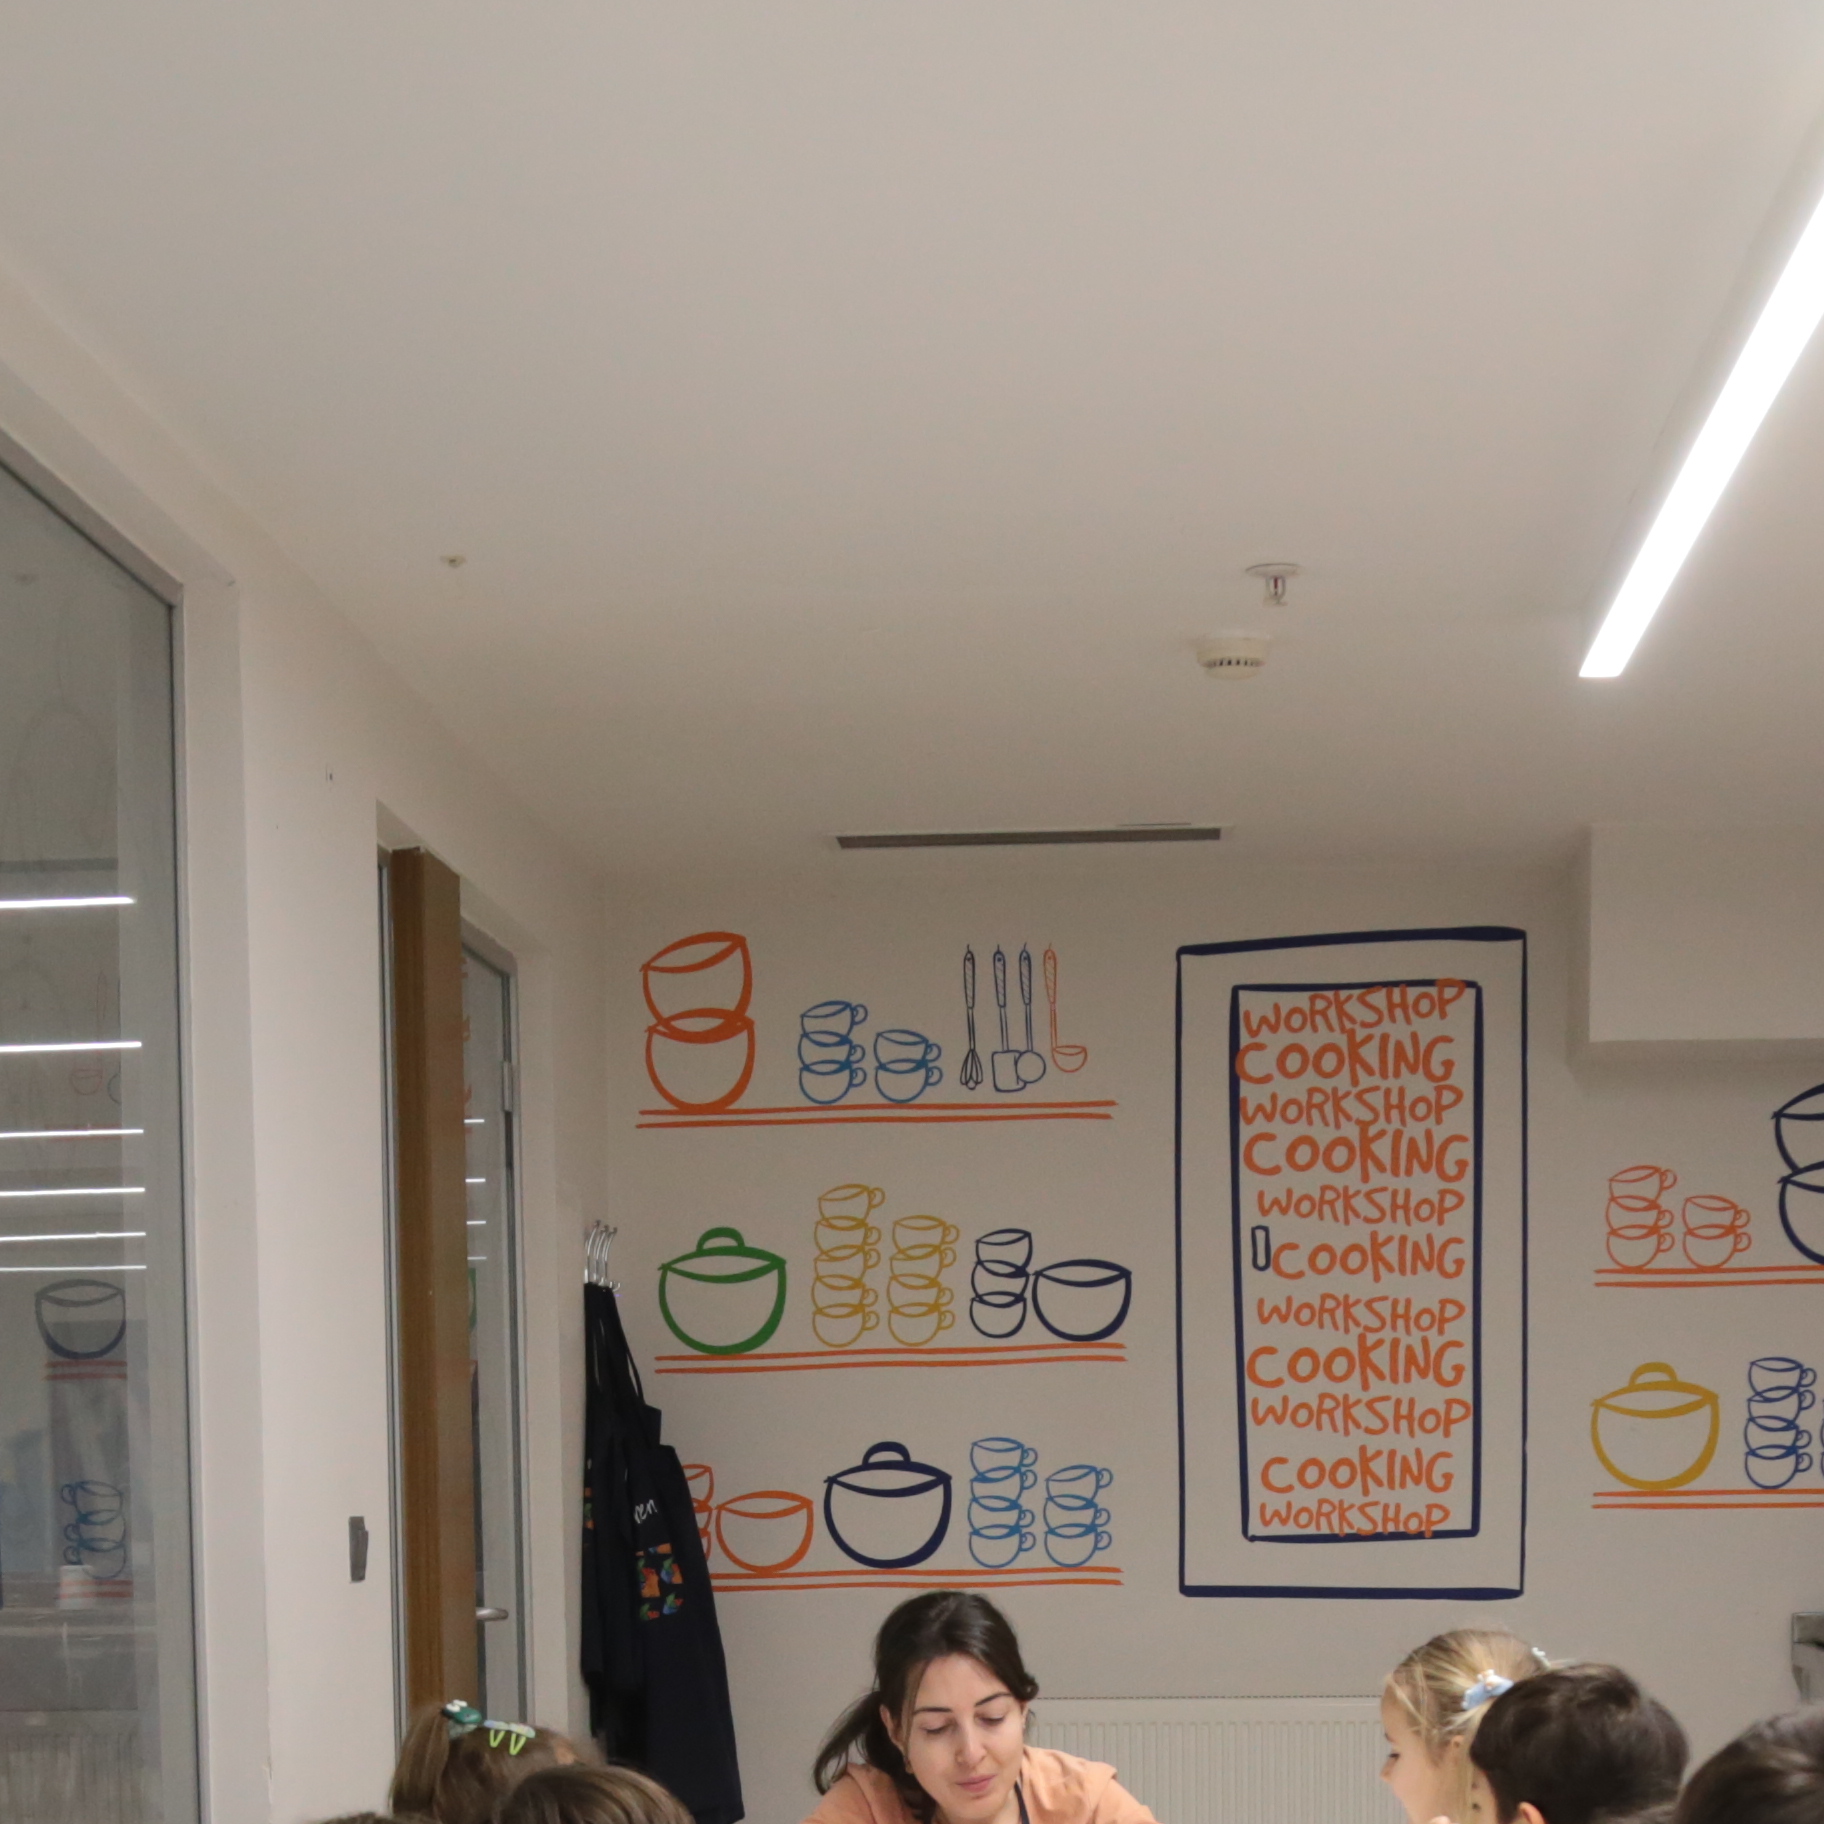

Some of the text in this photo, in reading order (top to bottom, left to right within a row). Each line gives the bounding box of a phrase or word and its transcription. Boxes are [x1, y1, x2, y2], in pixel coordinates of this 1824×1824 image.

[1242, 977, 1466, 1038] WORKSHOP
[1235, 1027, 1455, 1088] COOKING
[1240, 1084, 1464, 1130] WORKSHOP
[1243, 1122, 1470, 1184] COOKING
[1257, 1184, 1465, 1227] WORKSHOP
[1272, 1230, 1465, 1283] COOKING
[1257, 1292, 1466, 1336] WORKSHOP
[1246, 1332, 1466, 1392] COOKING
[1250, 1392, 1473, 1438] WORKSHOP
[1260, 1444, 1455, 1497] COOKING
[1259, 1498, 1452, 1538] WORKSHOP
